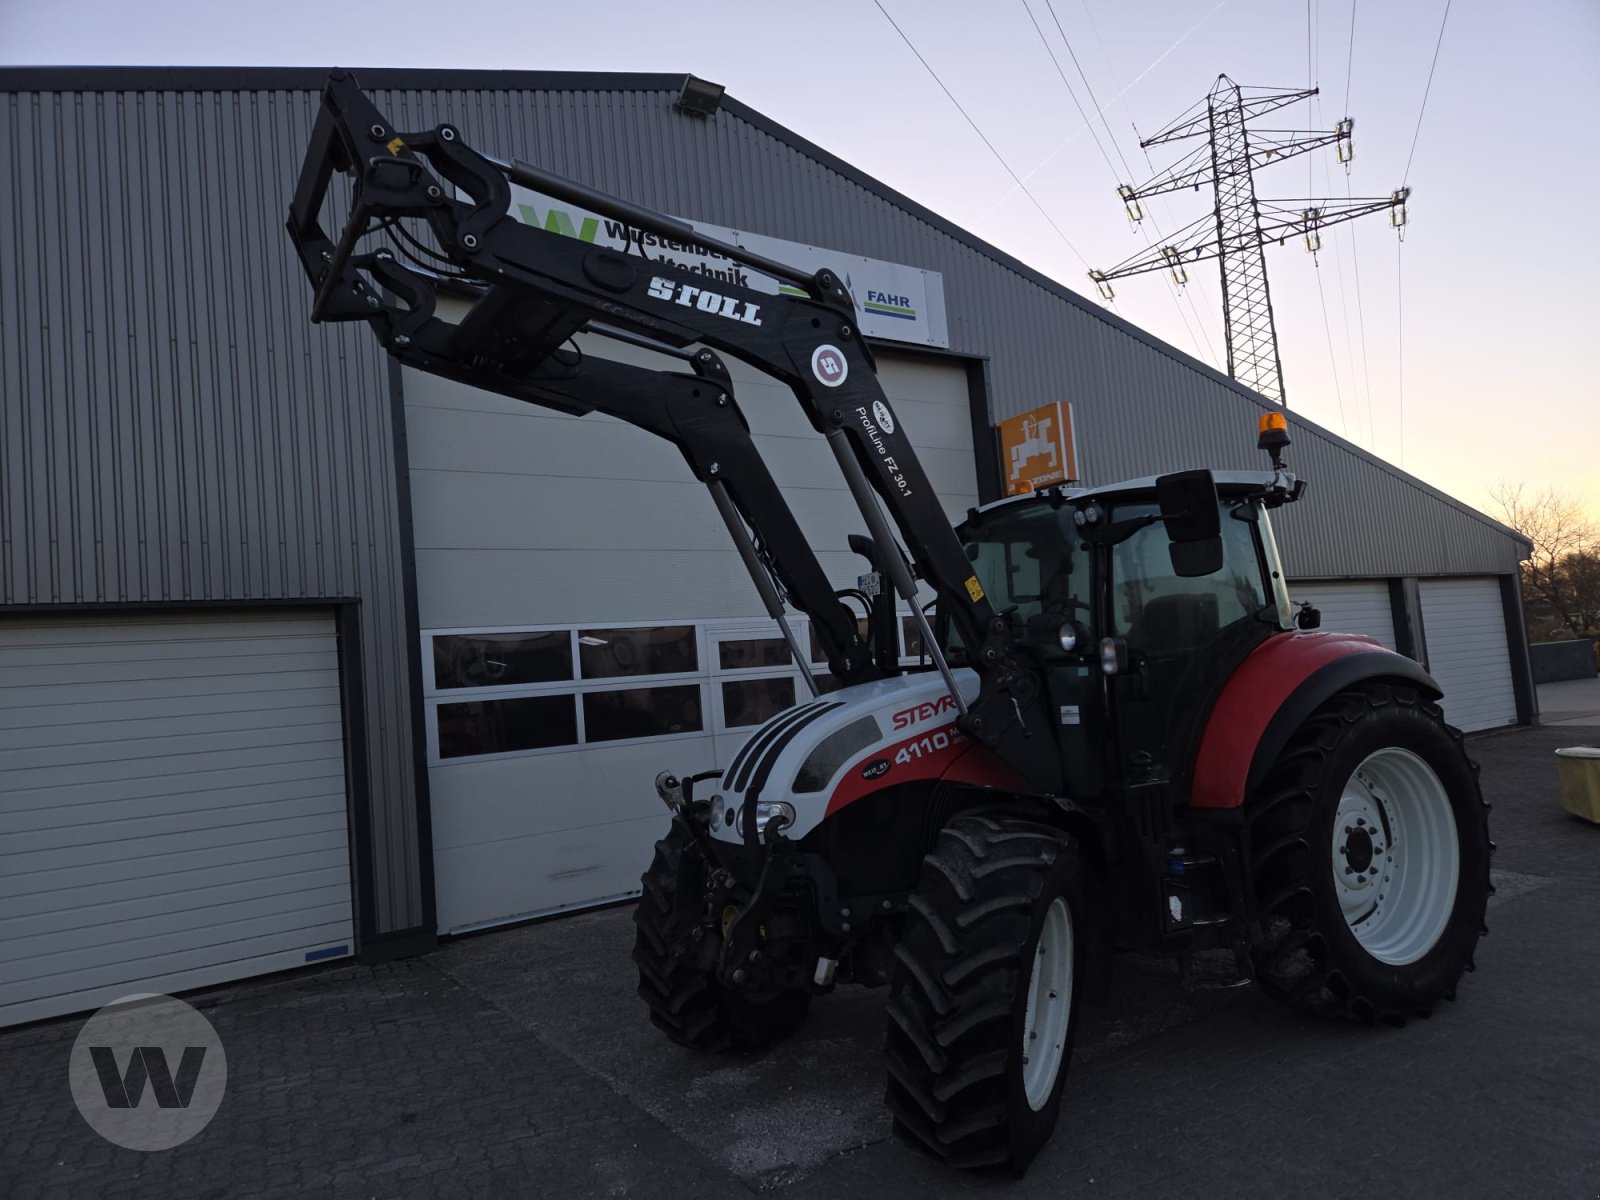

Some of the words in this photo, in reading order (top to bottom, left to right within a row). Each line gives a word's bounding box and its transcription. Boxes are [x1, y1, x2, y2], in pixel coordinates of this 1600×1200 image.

[647, 276, 762, 327] STOLL
[867, 290, 911, 308] FAHR
[855, 406, 886, 455] ProfiLine
[884, 456, 899, 474] FZ
[894, 473, 913, 497] 30.1
[892, 694, 957, 731] STEYR
[894, 731, 949, 766] 4110
